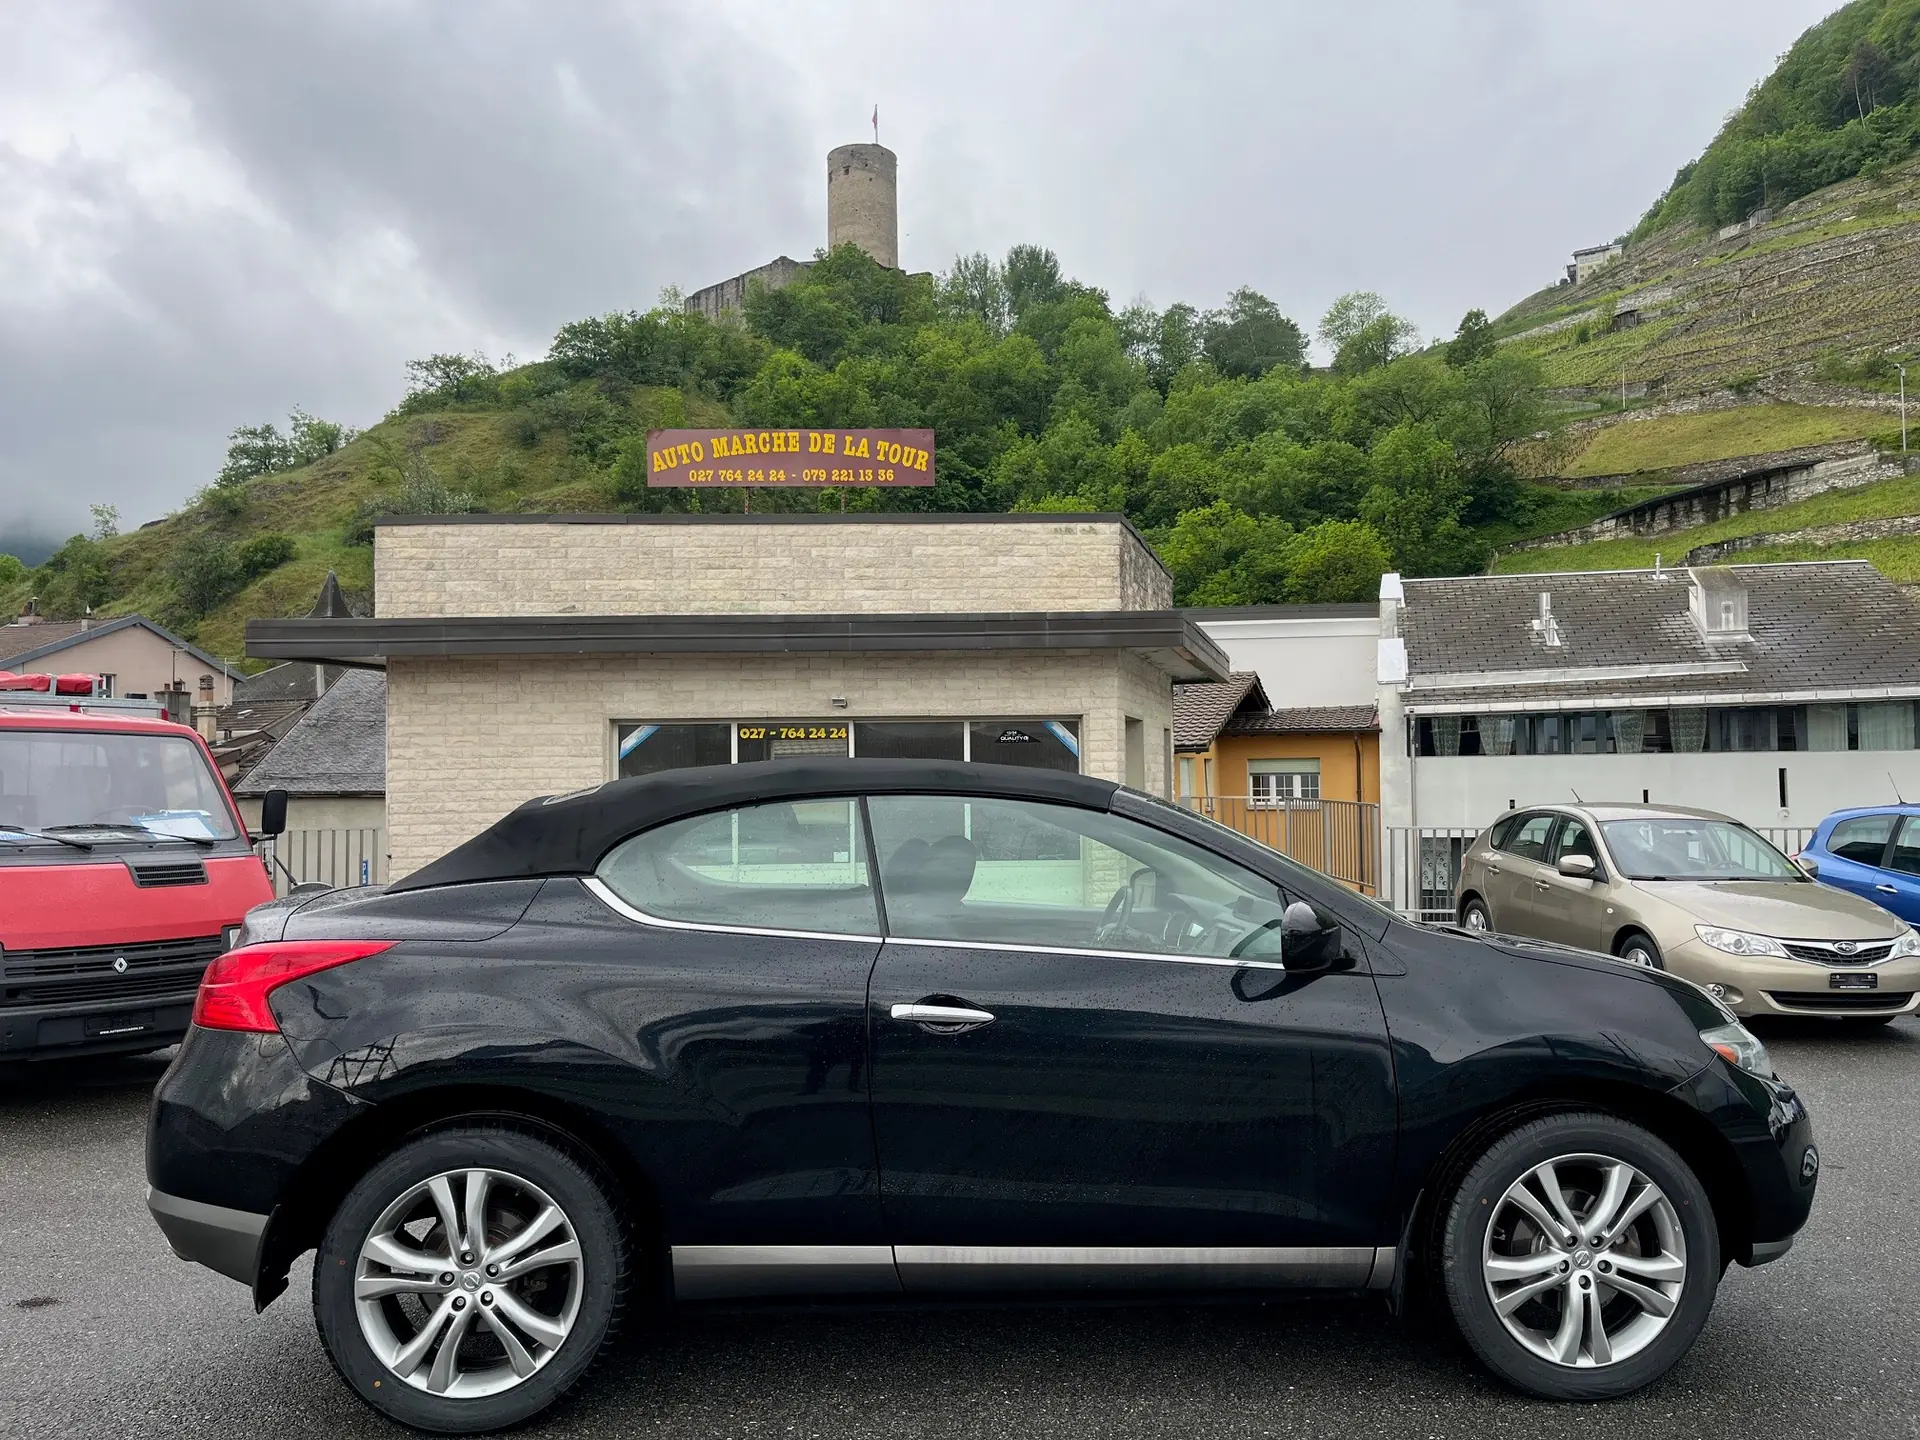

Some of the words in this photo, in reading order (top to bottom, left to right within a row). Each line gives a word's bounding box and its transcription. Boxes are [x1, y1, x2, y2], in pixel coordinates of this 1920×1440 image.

[652, 441, 704, 473] AUTO
[710, 432, 800, 459] MARCHE
[808, 432, 836, 454] DE
[843, 435, 870, 459] LA
[876, 440, 929, 472] TOUR
[689, 469, 714, 482] 027
[718, 469, 743, 482] 764
[747, 469, 764, 482] 24
[769, 469, 786, 482] 24
[802, 469, 827, 482] 079
[831, 469, 855, 482] 221
[858, 469, 873, 482] 13
[877, 469, 895, 482] 36
[740, 728, 766, 739] 027
[780, 728, 806, 739] 764
[809, 728, 827, 739] 24
[829, 728, 848, 739] 24
